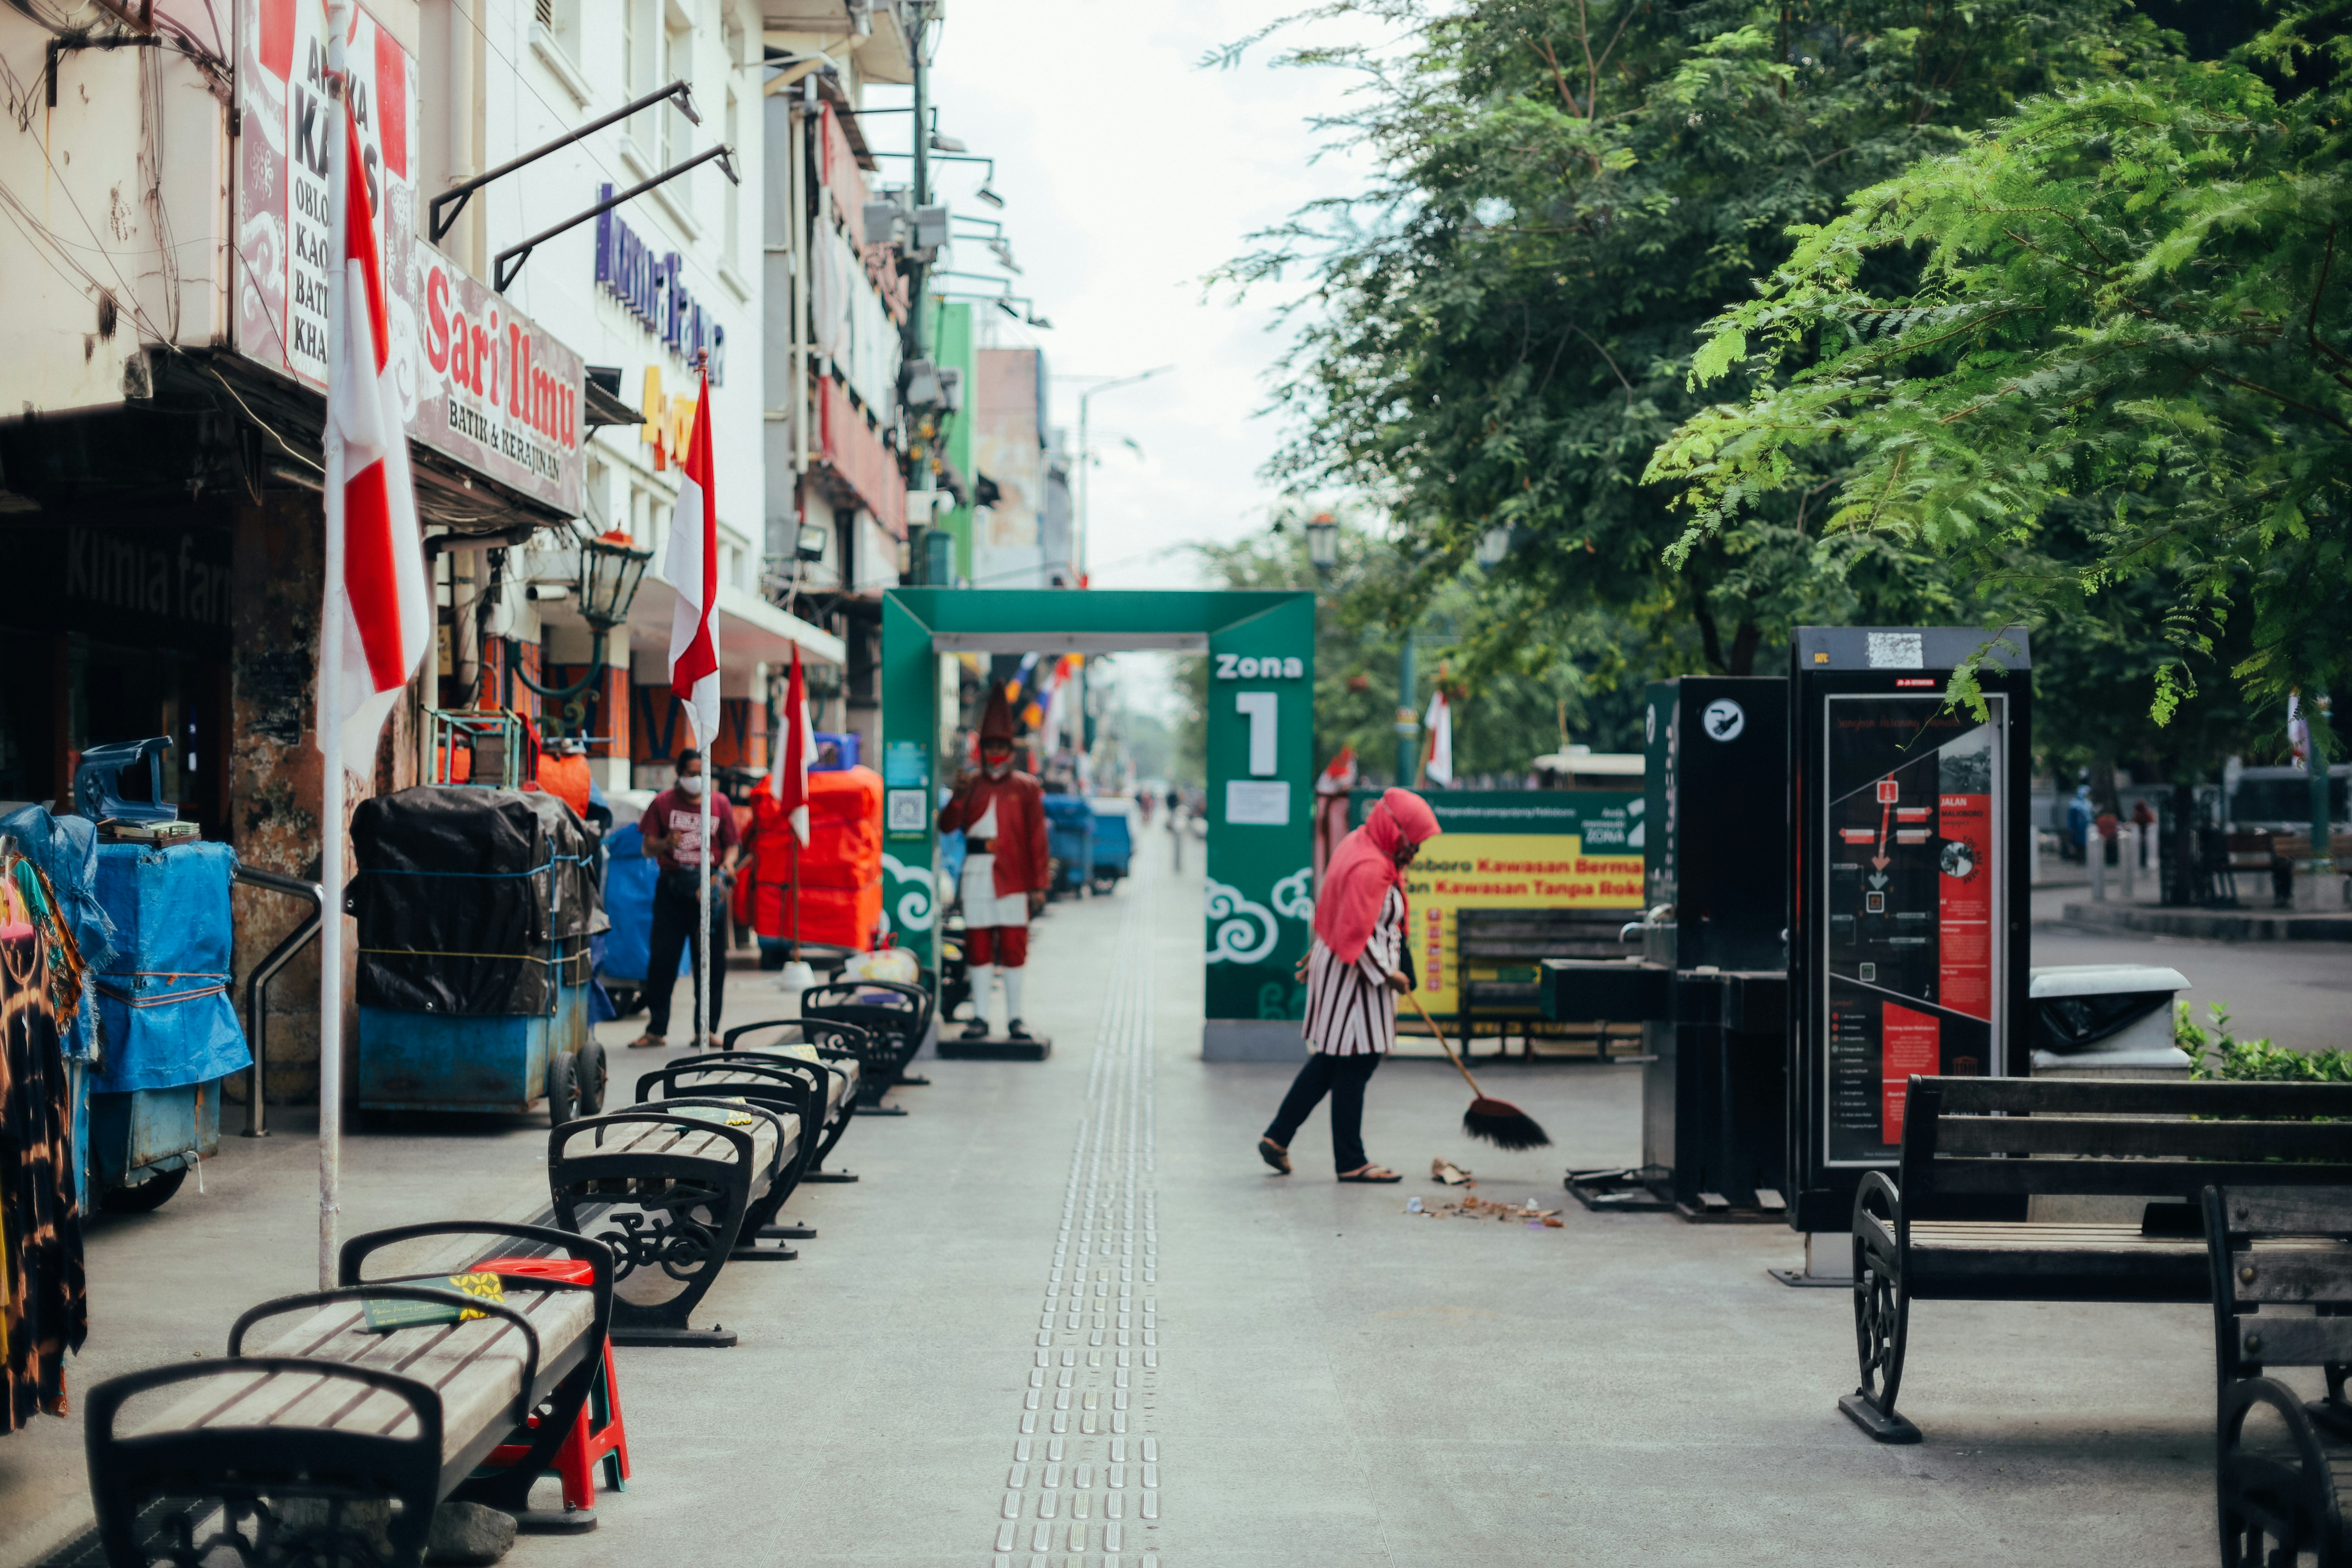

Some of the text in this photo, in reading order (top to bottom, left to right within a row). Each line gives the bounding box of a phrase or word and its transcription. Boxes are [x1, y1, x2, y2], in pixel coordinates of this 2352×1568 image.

[295, 176, 328, 227] OBLO
[296, 222, 328, 270] KAO
[296, 268, 328, 319] BATI
[294, 315, 327, 364] KHA
[426, 265, 500, 407] Sari
[508, 322, 575, 450] Ilmu
[449, 398, 560, 482] BATIK & KERAJINAN
[1215, 654, 1303, 678] Zona
[1236, 692, 1278, 776] 1
[1941, 798, 1968, 806] JALAN
[1586, 829, 1626, 844] ZONA
[1435, 879, 1528, 896] Kawasan
[1532, 879, 1594, 900] Tanpa
[1477, 858, 1570, 874] Kawasan
[1575, 858, 1644, 874] Berma
